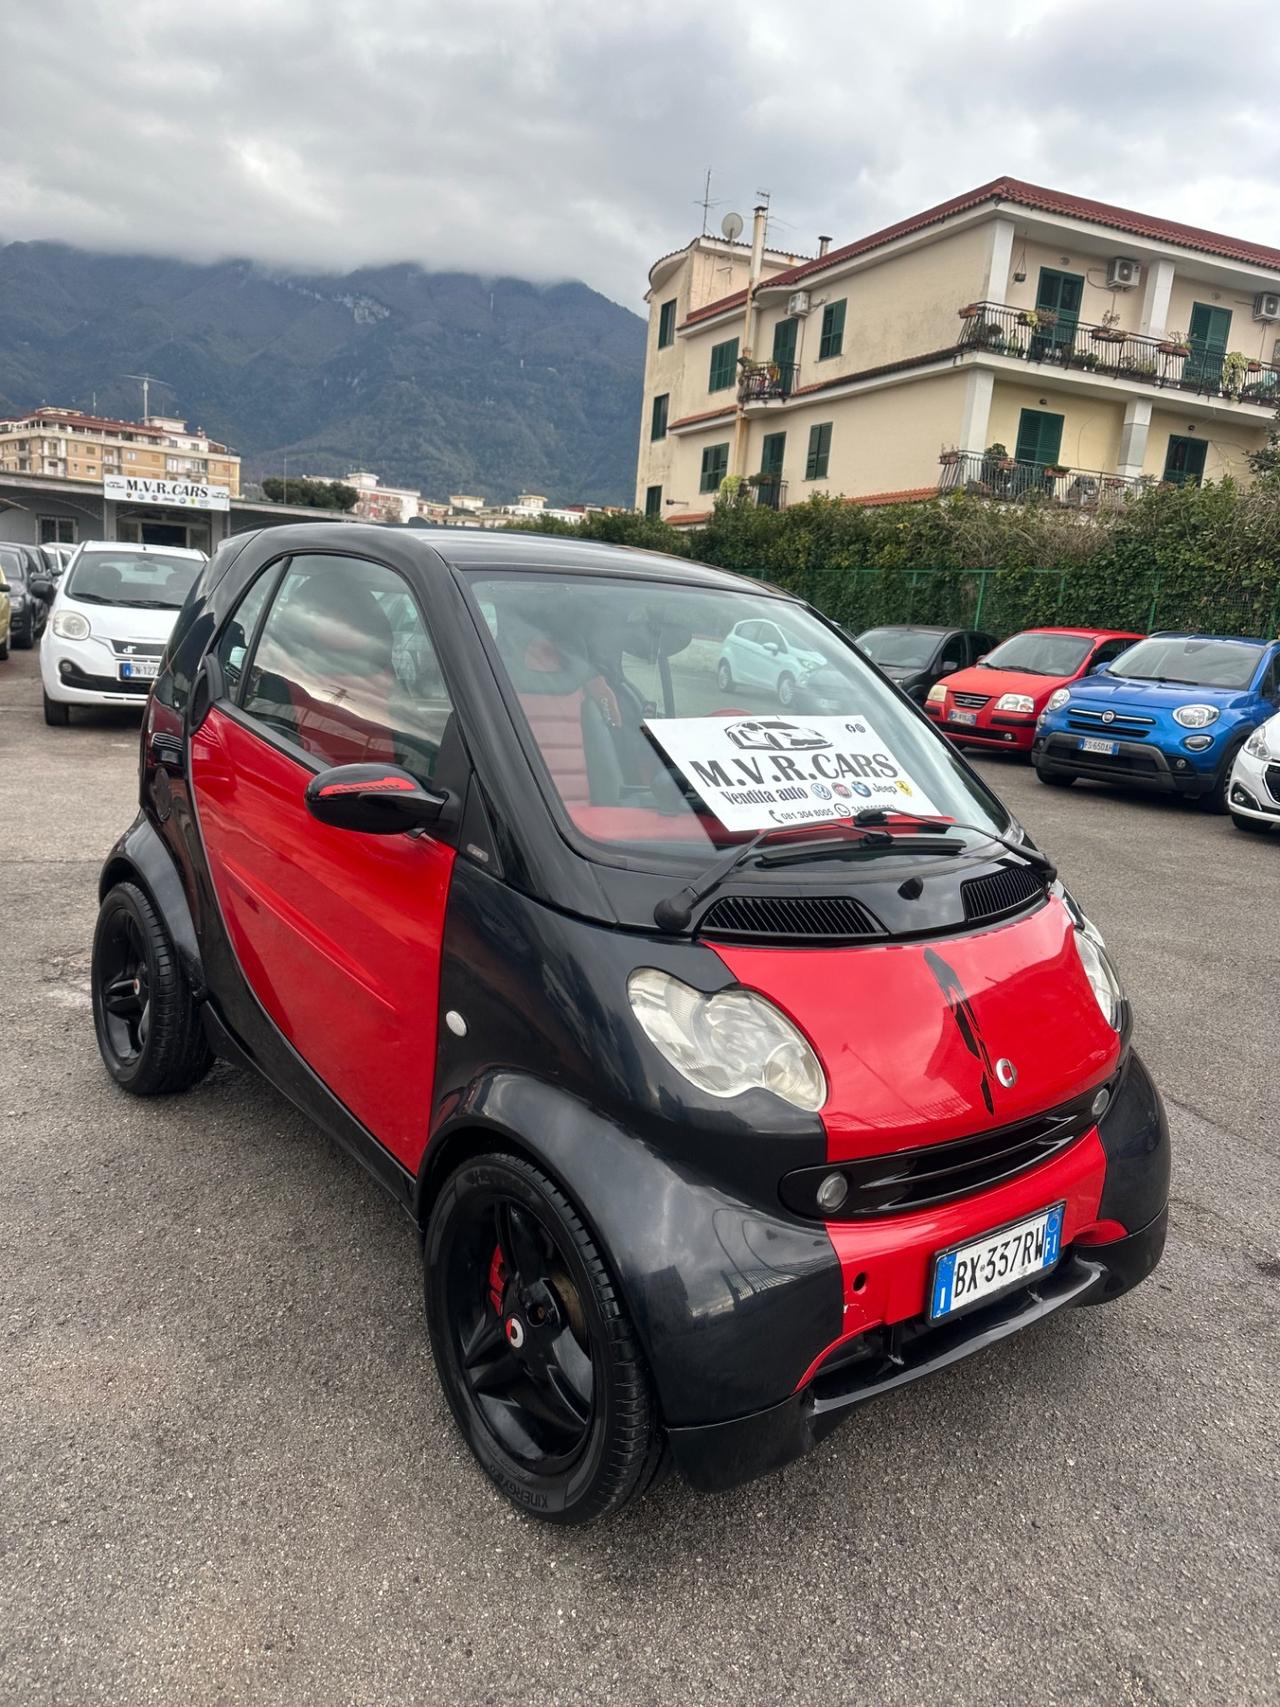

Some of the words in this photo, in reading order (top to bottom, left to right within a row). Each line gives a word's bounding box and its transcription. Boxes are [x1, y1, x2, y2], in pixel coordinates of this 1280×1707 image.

[127, 479, 208, 498] M.V.R.CARS
[688, 753, 899, 788] M.V.R.CARS
[721, 787, 772, 806] Vendita
[775, 783, 809, 803] auto
[872, 782, 898, 795] Jeep
[780, 812, 798, 820] 081
[797, 809, 814, 819] 304
